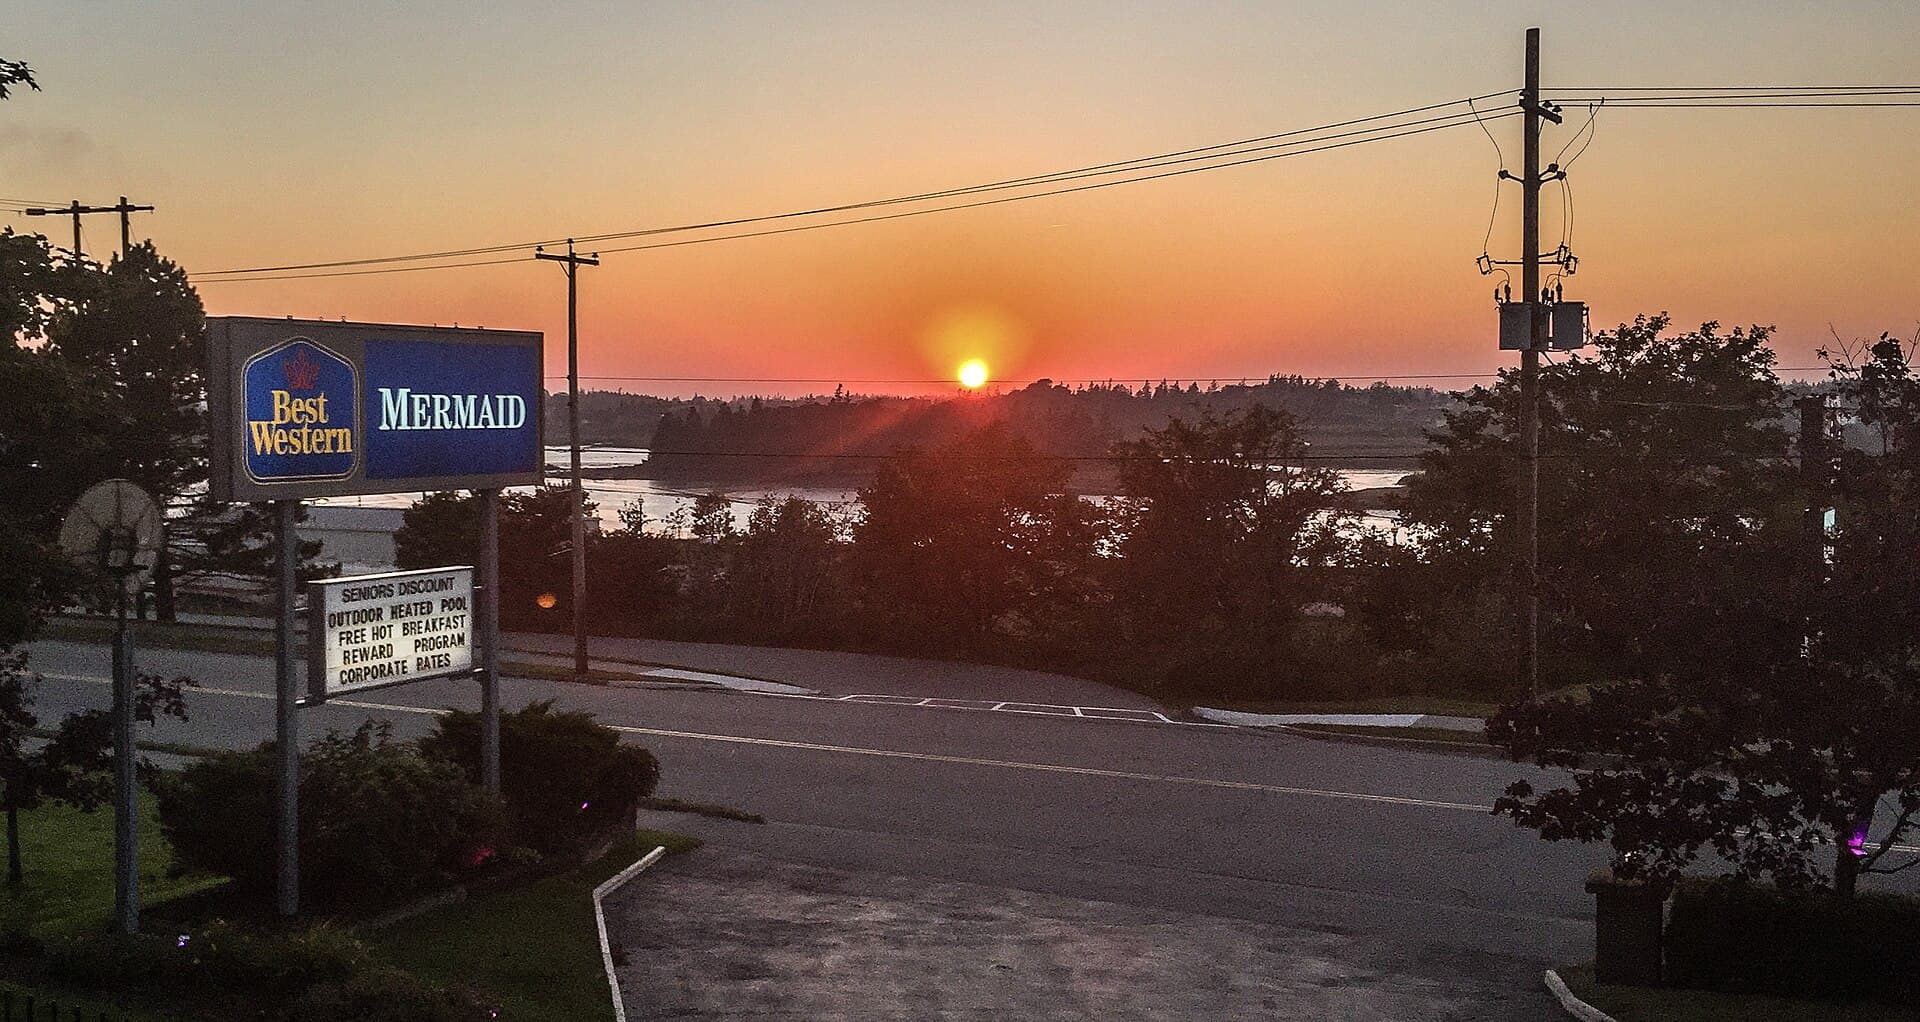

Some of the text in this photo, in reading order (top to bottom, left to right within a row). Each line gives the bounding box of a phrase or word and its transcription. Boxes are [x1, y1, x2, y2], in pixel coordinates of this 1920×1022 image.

[272, 390, 328, 425] Best
[250, 420, 352, 455] Western
[342, 577, 455, 603] SENIORS DISCOUNT
[329, 596, 468, 628] OUTDOOR HEATED POOL
[339, 615, 466, 646] FREE HOT BREAKFAST
[343, 632, 465, 665] REWARD PROGRAM
[340, 660, 408, 685] CORPORATE
